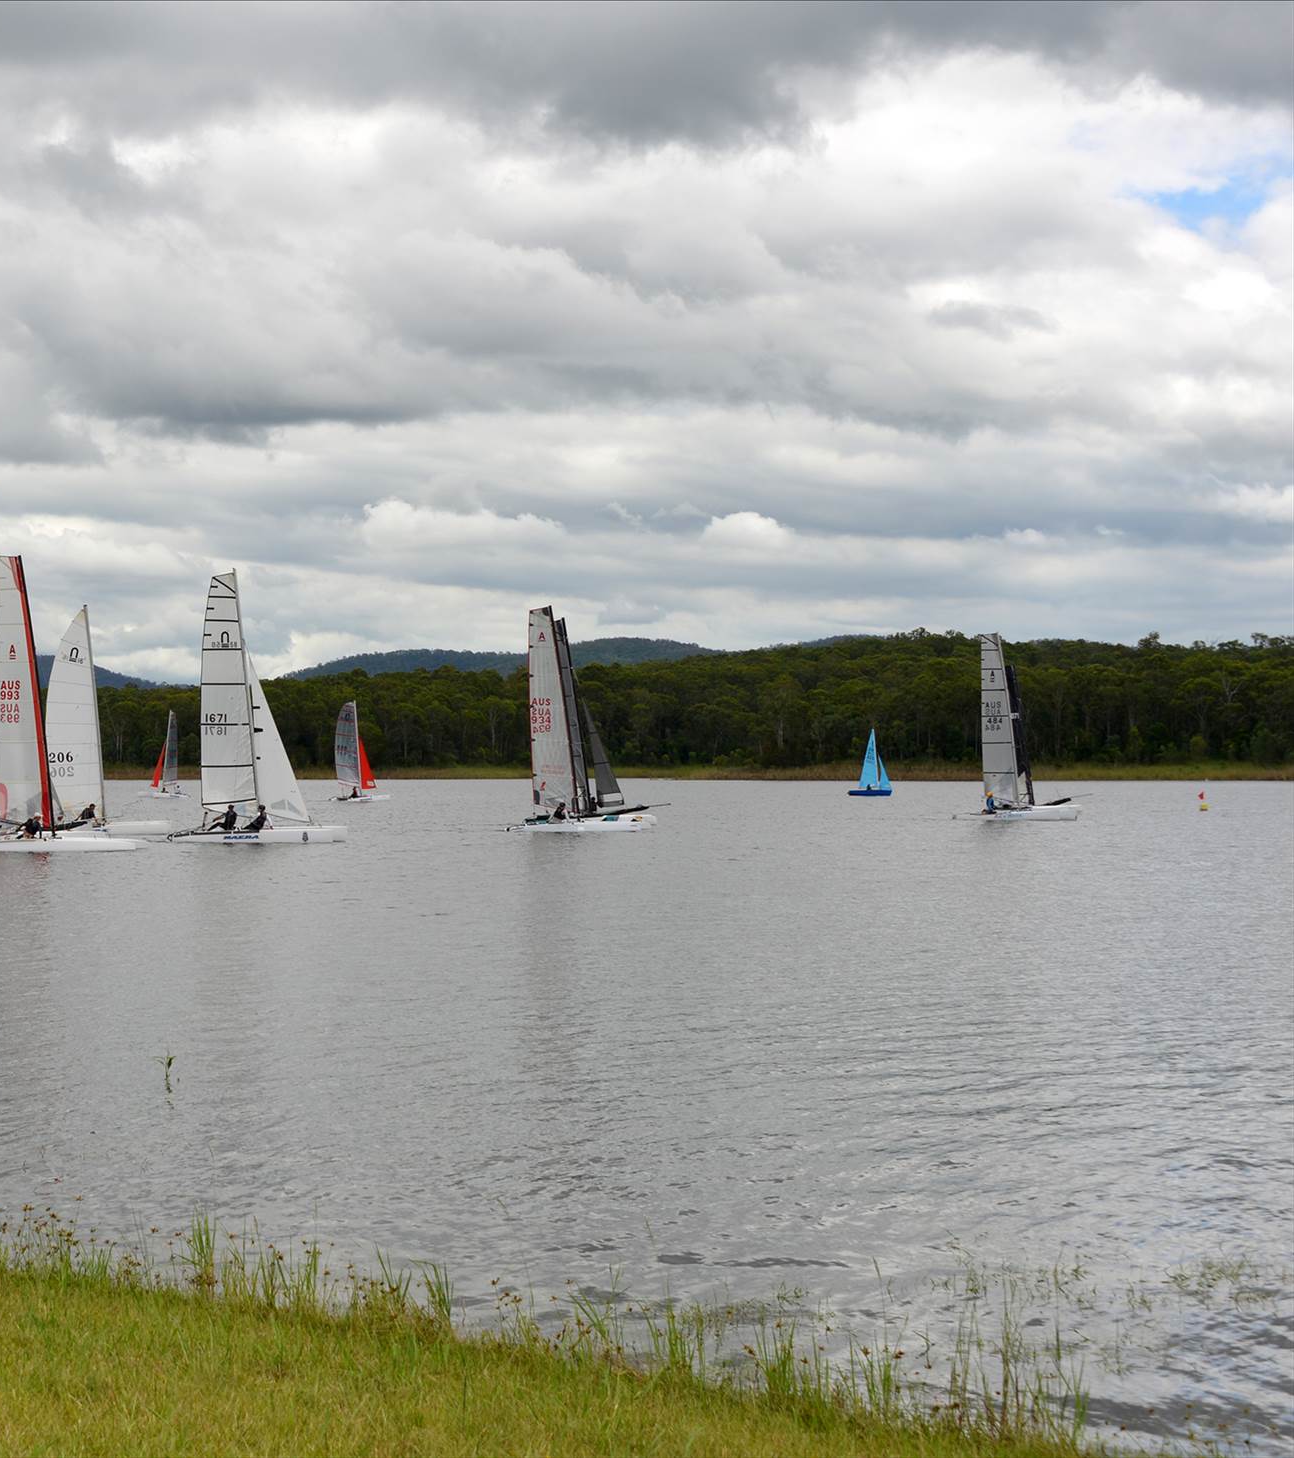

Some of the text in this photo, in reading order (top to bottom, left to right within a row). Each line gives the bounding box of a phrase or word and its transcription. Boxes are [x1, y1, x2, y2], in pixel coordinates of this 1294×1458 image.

[0, 680, 21, 690] AUS
[0, 690, 20, 701] 993
[531, 698, 551, 706] AUS
[205, 713, 227, 722] 1671
[531, 716, 551, 724] 934
[49, 752, 73, 763] 206
